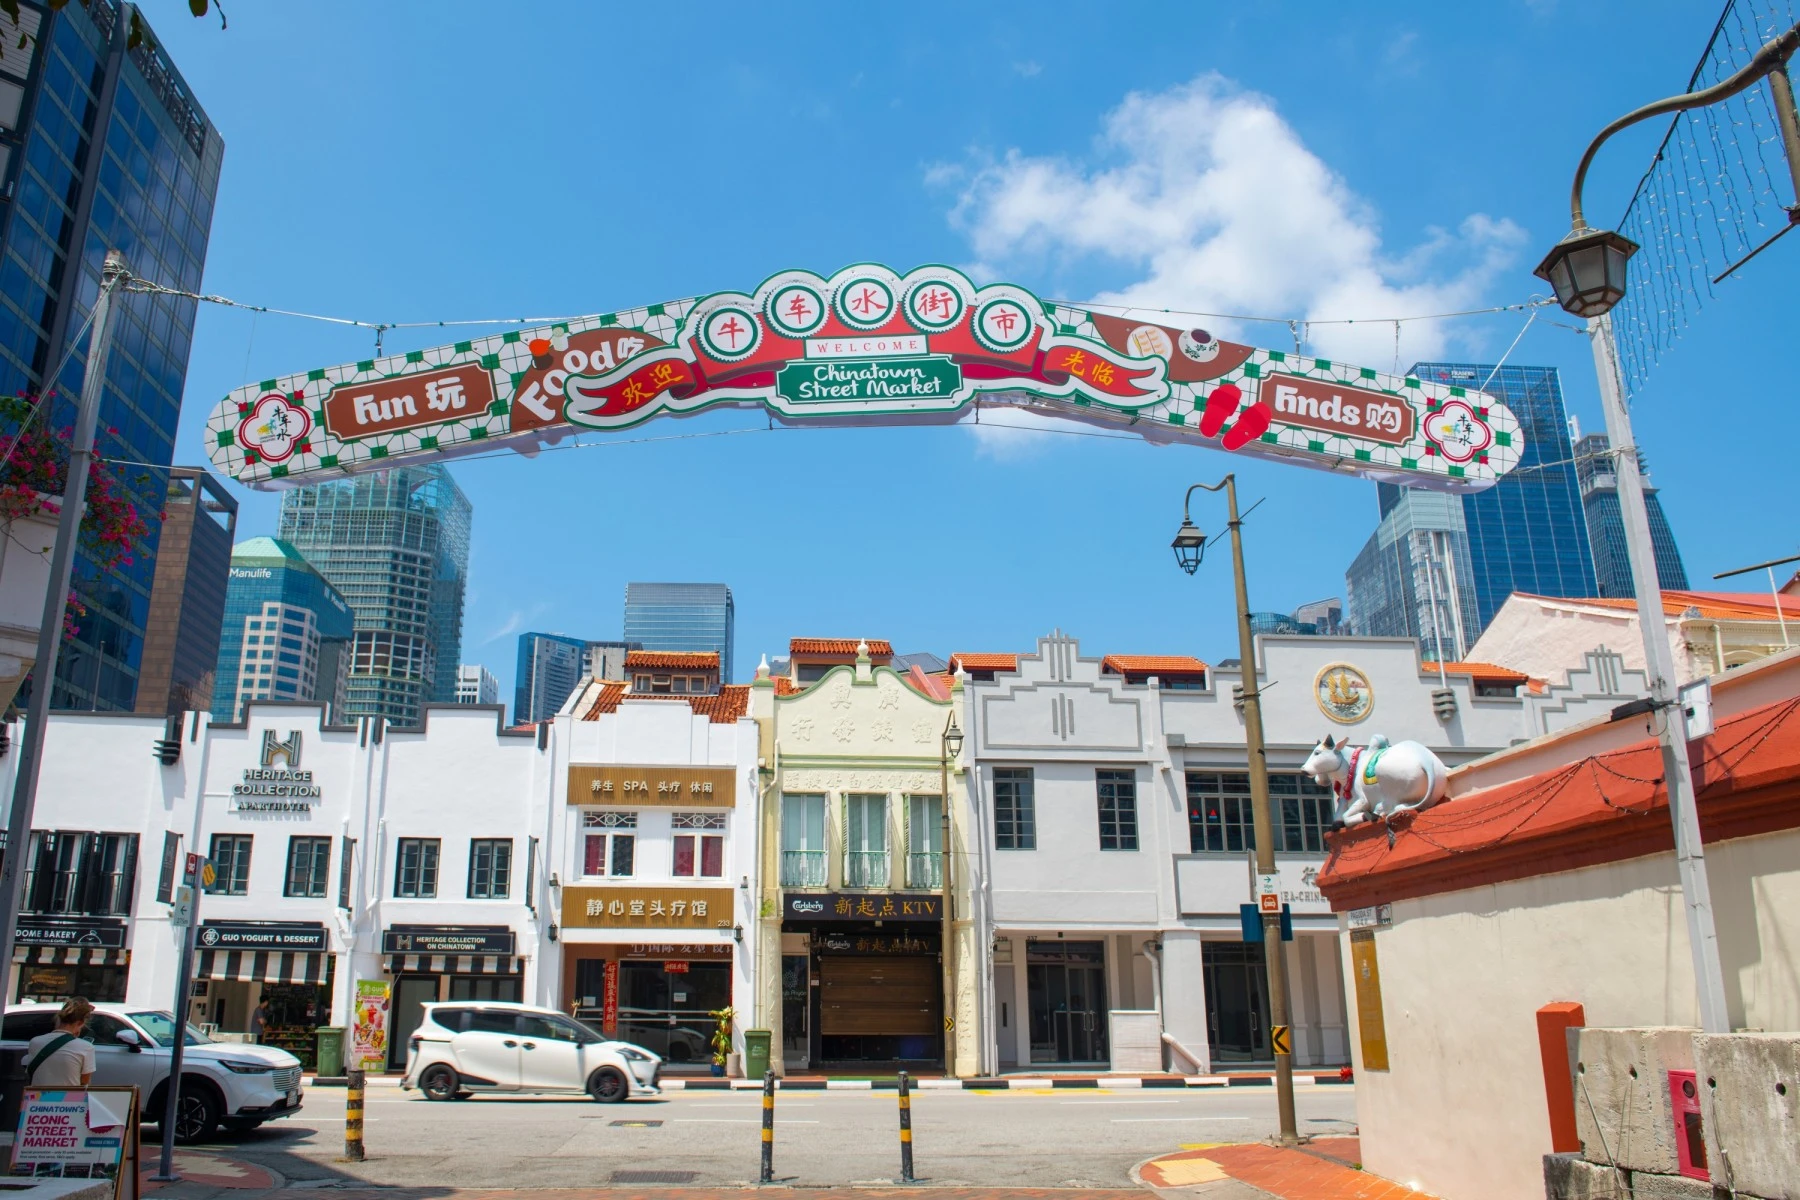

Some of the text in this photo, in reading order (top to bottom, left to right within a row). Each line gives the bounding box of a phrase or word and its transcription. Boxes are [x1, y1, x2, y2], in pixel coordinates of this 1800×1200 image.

[717, 287, 1019, 349] 牛车水街市
[817, 340, 918, 353] WELCOME
[813, 363, 925, 382] Chinatown
[1061, 350, 1115, 387] 光临
[518, 336, 644, 421] Food 吃
[622, 363, 684, 406] 欢迎
[798, 378, 941, 398] Street Market
[353, 376, 466, 425] Fun 玩
[272, 405, 292, 442] 牛车水
[1366, 402, 1402, 434] 购
[1457, 413, 1474, 446] 牛车水
[229, 567, 272, 578] Manulife
[244, 769, 312, 781] HERITAGE
[232, 784, 321, 798] COLLECTION
[591, 780, 713, 793] 养生 SPA 头疗 休闲
[238, 802, 310, 811] APARTHOTEL
[586, 899, 707, 916] 静心堂头疗馆
[792, 900, 823, 912] Carlsberg
[835, 897, 936, 917] 新起点 KTV
[1350, 909, 1366, 919] PAGODA
[15, 929, 77, 939] DOME BAKERY
[241, 934, 274, 942] YOGURT
[283, 935, 319, 943] DESSERT
[29, 1105, 85, 1113] CHINATOWN'S
[27, 1115, 69, 1125] ICONIC
[25, 1126, 76, 1136] STREET
[22, 1137, 78, 1147] MARKET
